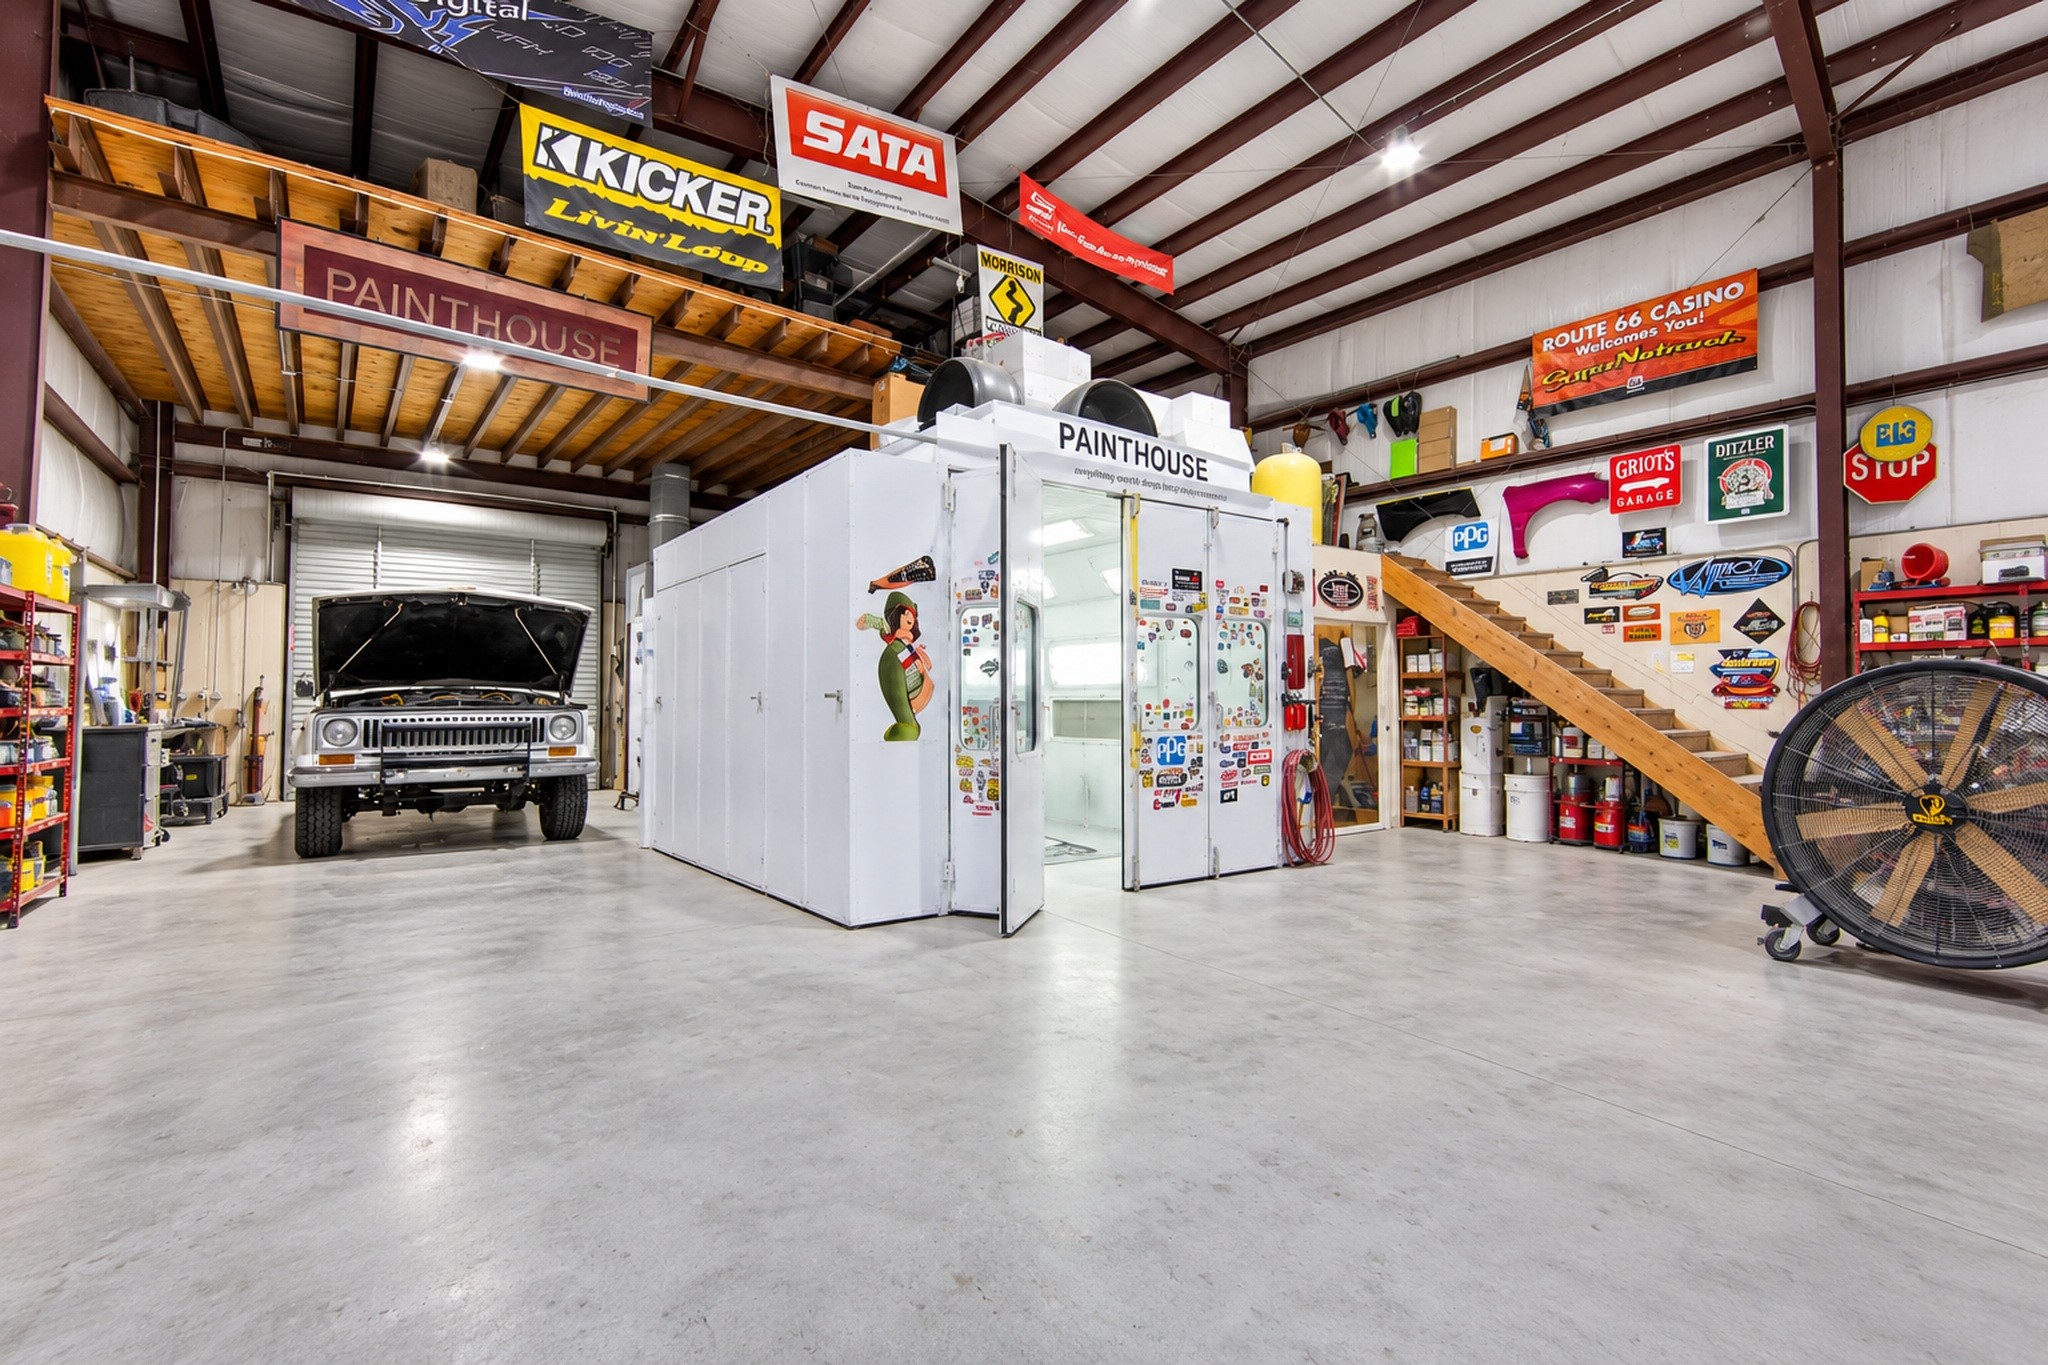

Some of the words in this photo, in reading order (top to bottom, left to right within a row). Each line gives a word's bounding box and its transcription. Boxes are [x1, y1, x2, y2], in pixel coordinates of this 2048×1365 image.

[803, 110, 937, 183] SATA
[582, 140, 773, 235] KICKER
[980, 250, 1041, 285] MORRISON
[327, 266, 622, 367] PAINTHOUSE
[1542, 321, 1607, 353] ROUTE
[1614, 311, 1643, 332] 66
[1650, 281, 1745, 322] CASINO
[1576, 327, 1659, 356] Welcomes
[1665, 310, 1705, 333] You!
[1059, 421, 1209, 482] PAINTHOUSE
[1615, 448, 1675, 480] GRIOT'S
[1715, 435, 1775, 458] DITZLER
[1851, 449, 1930, 481] STOP
[1616, 489, 1674, 508] GARAGE
[1454, 525, 1488, 549] PPG
[1158, 738, 1185, 763] PPG
